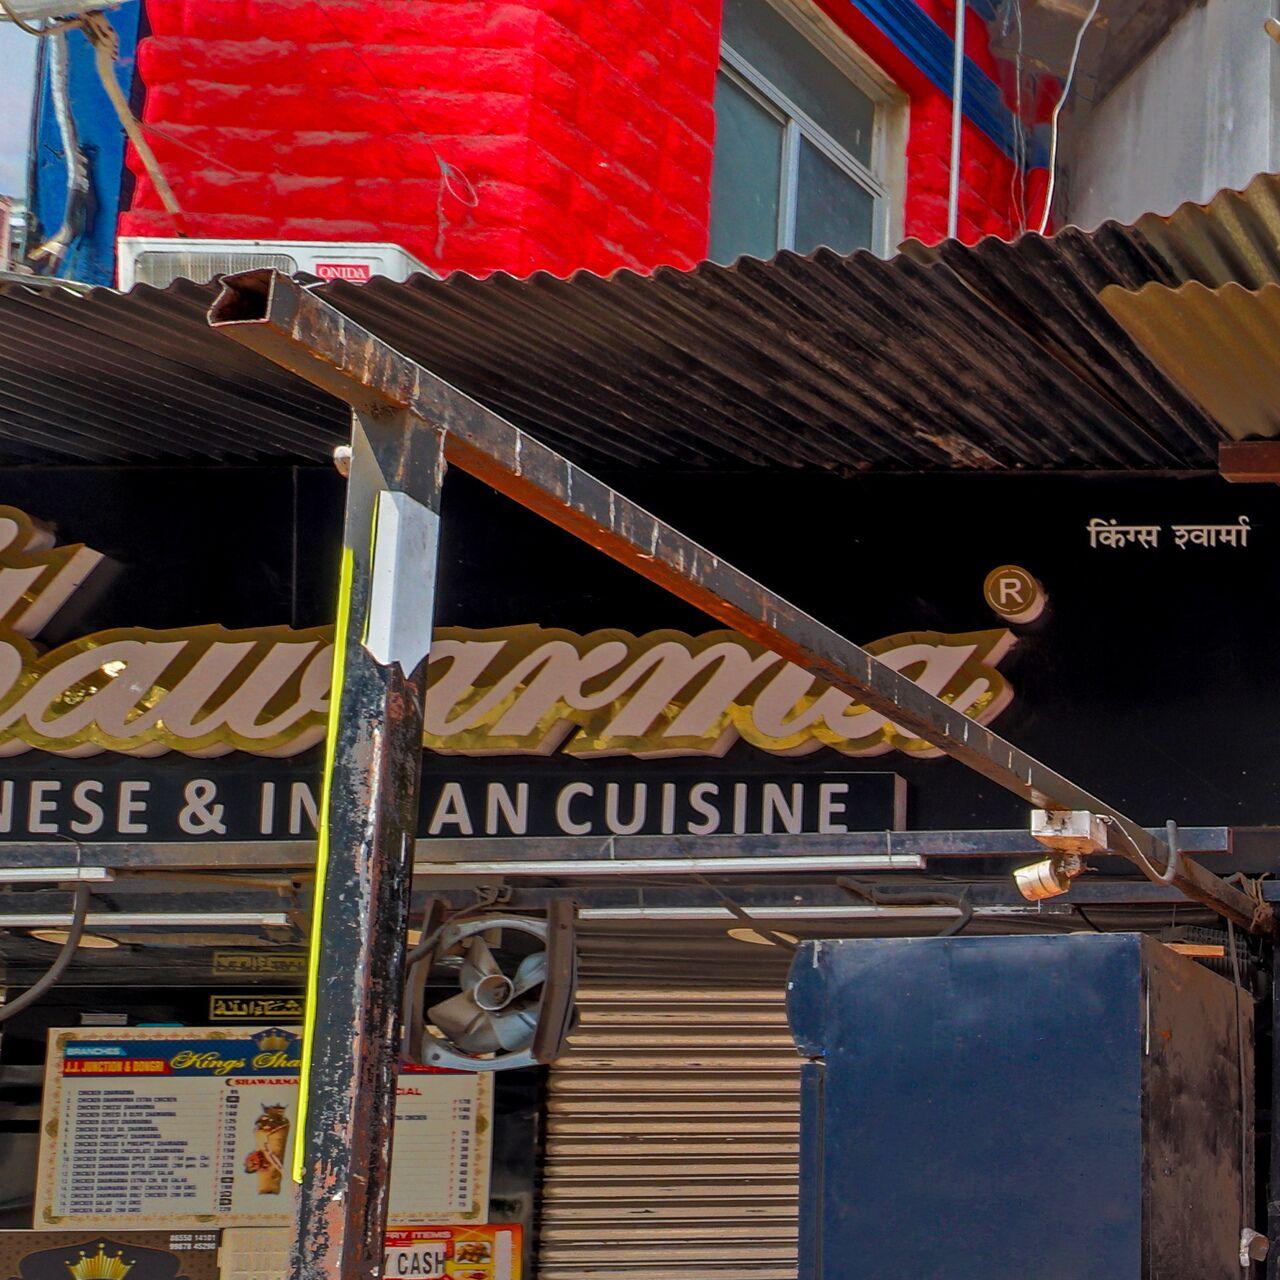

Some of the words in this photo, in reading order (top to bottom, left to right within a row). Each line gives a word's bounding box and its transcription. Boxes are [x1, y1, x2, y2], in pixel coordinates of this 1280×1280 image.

[319, 266, 367, 278] ONIDA
[1086, 518, 1161, 549] किंग्स
[178, 780, 226, 834] &
[260, 780, 529, 835] INAN
[555, 781, 850, 836] CUISINE
[170, 1050, 246, 1076] Kings
[397, 1251, 446, 1275] CASH
